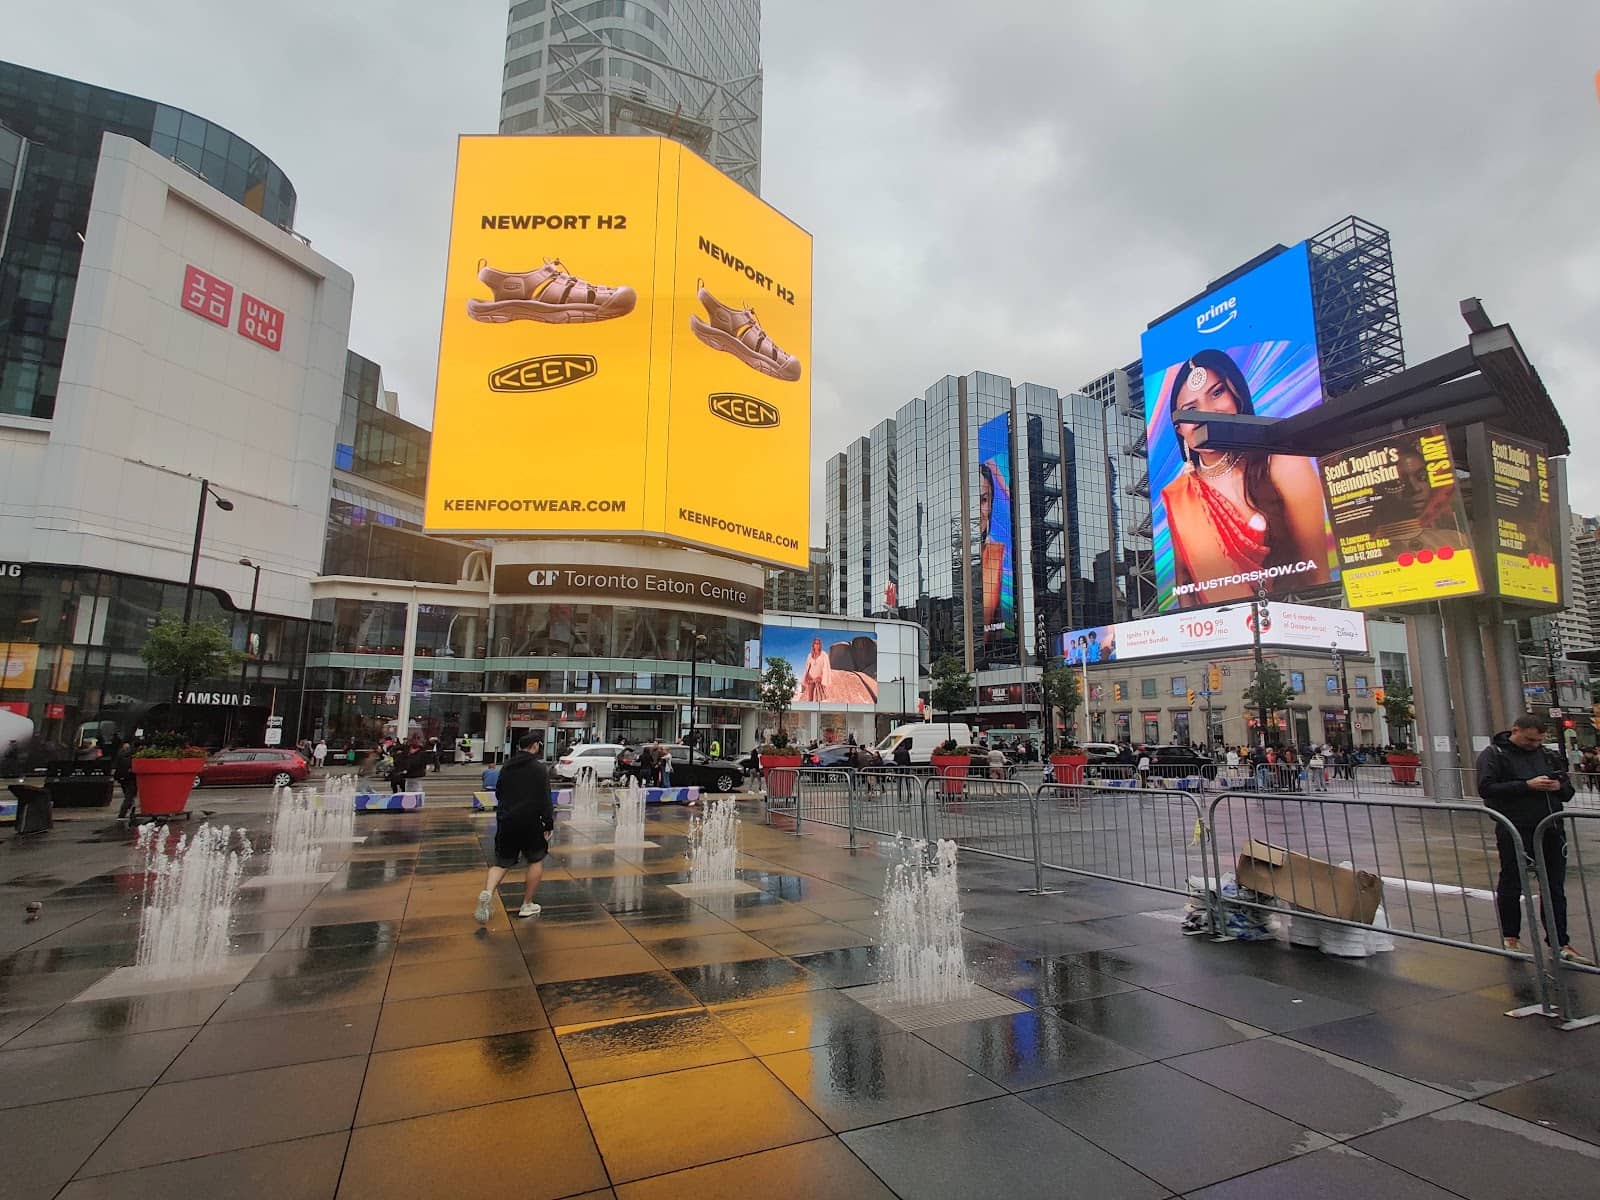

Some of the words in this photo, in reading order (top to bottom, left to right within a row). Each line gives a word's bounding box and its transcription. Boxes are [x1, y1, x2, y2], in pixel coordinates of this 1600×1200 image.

[481, 215, 590, 229] NEWPORT
[597, 215, 626, 229] H2
[699, 235, 773, 291] NEWPORT
[777, 283, 795, 306] H2
[1196, 297, 1236, 329] prime
[494, 360, 591, 387] KEEN
[713, 399, 777, 422] KEEN
[1420, 434, 1450, 459] ART
[1324, 460, 1349, 482] Scott
[1349, 447, 1399, 474] Joplin's
[1327, 464, 1399, 496] Treemonisha
[443, 499, 626, 512] KEENFOOTWEAR.COM
[679, 508, 799, 550] KEENFOOTWEAR.COM
[528, 570, 560, 586] CF
[564, 571, 639, 590] Toronto
[645, 575, 695, 595] Eaton
[700, 581, 747, 603] Centre
[1172, 560, 1317, 596] NOTJUSTFORSHOW.CA
